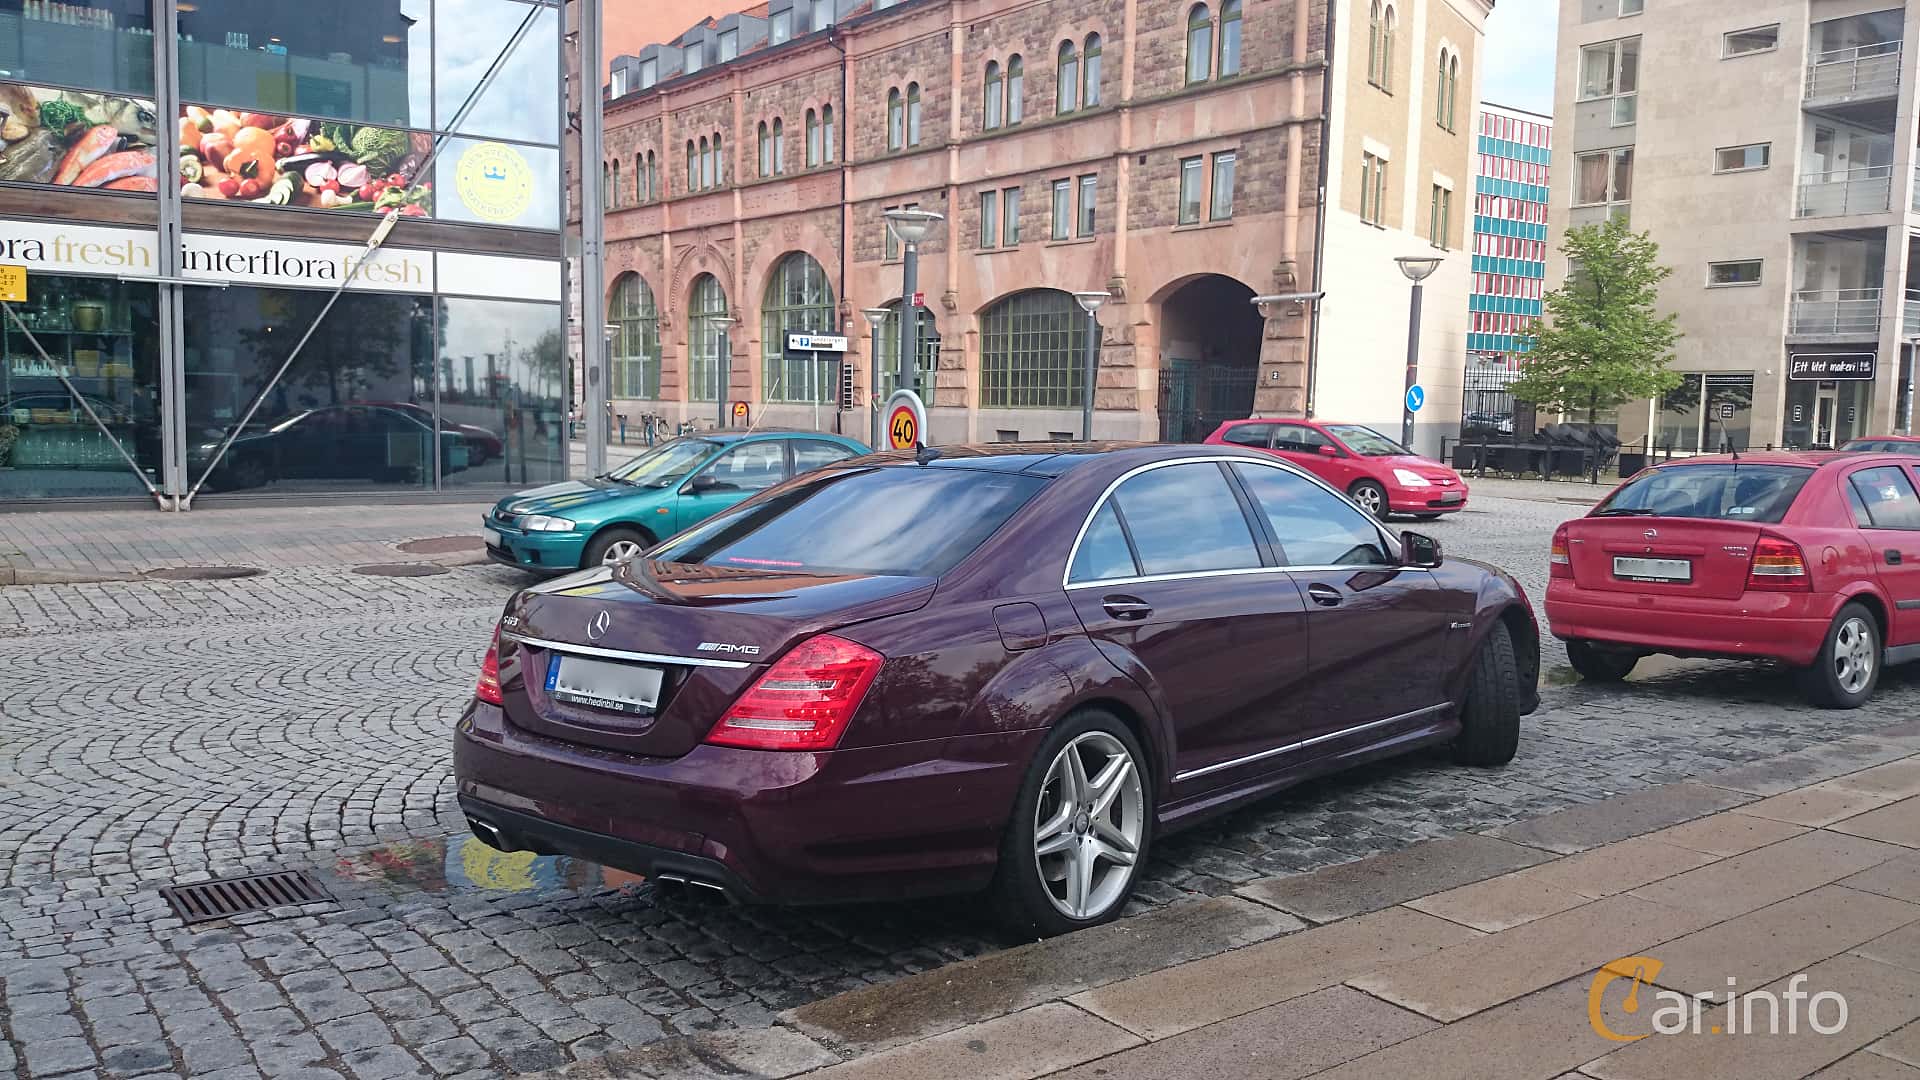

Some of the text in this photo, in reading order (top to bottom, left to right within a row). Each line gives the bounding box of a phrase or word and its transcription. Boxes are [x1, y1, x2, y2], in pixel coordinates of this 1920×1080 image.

[0, 234, 151, 268] ra fresh
[181, 244, 336, 280] interflora
[1793, 361, 1808, 373] Ett
[893, 418, 914, 443] 40
[716, 643, 760, 655] AMG
[571, 695, 624, 711] www.hedinbil.se
